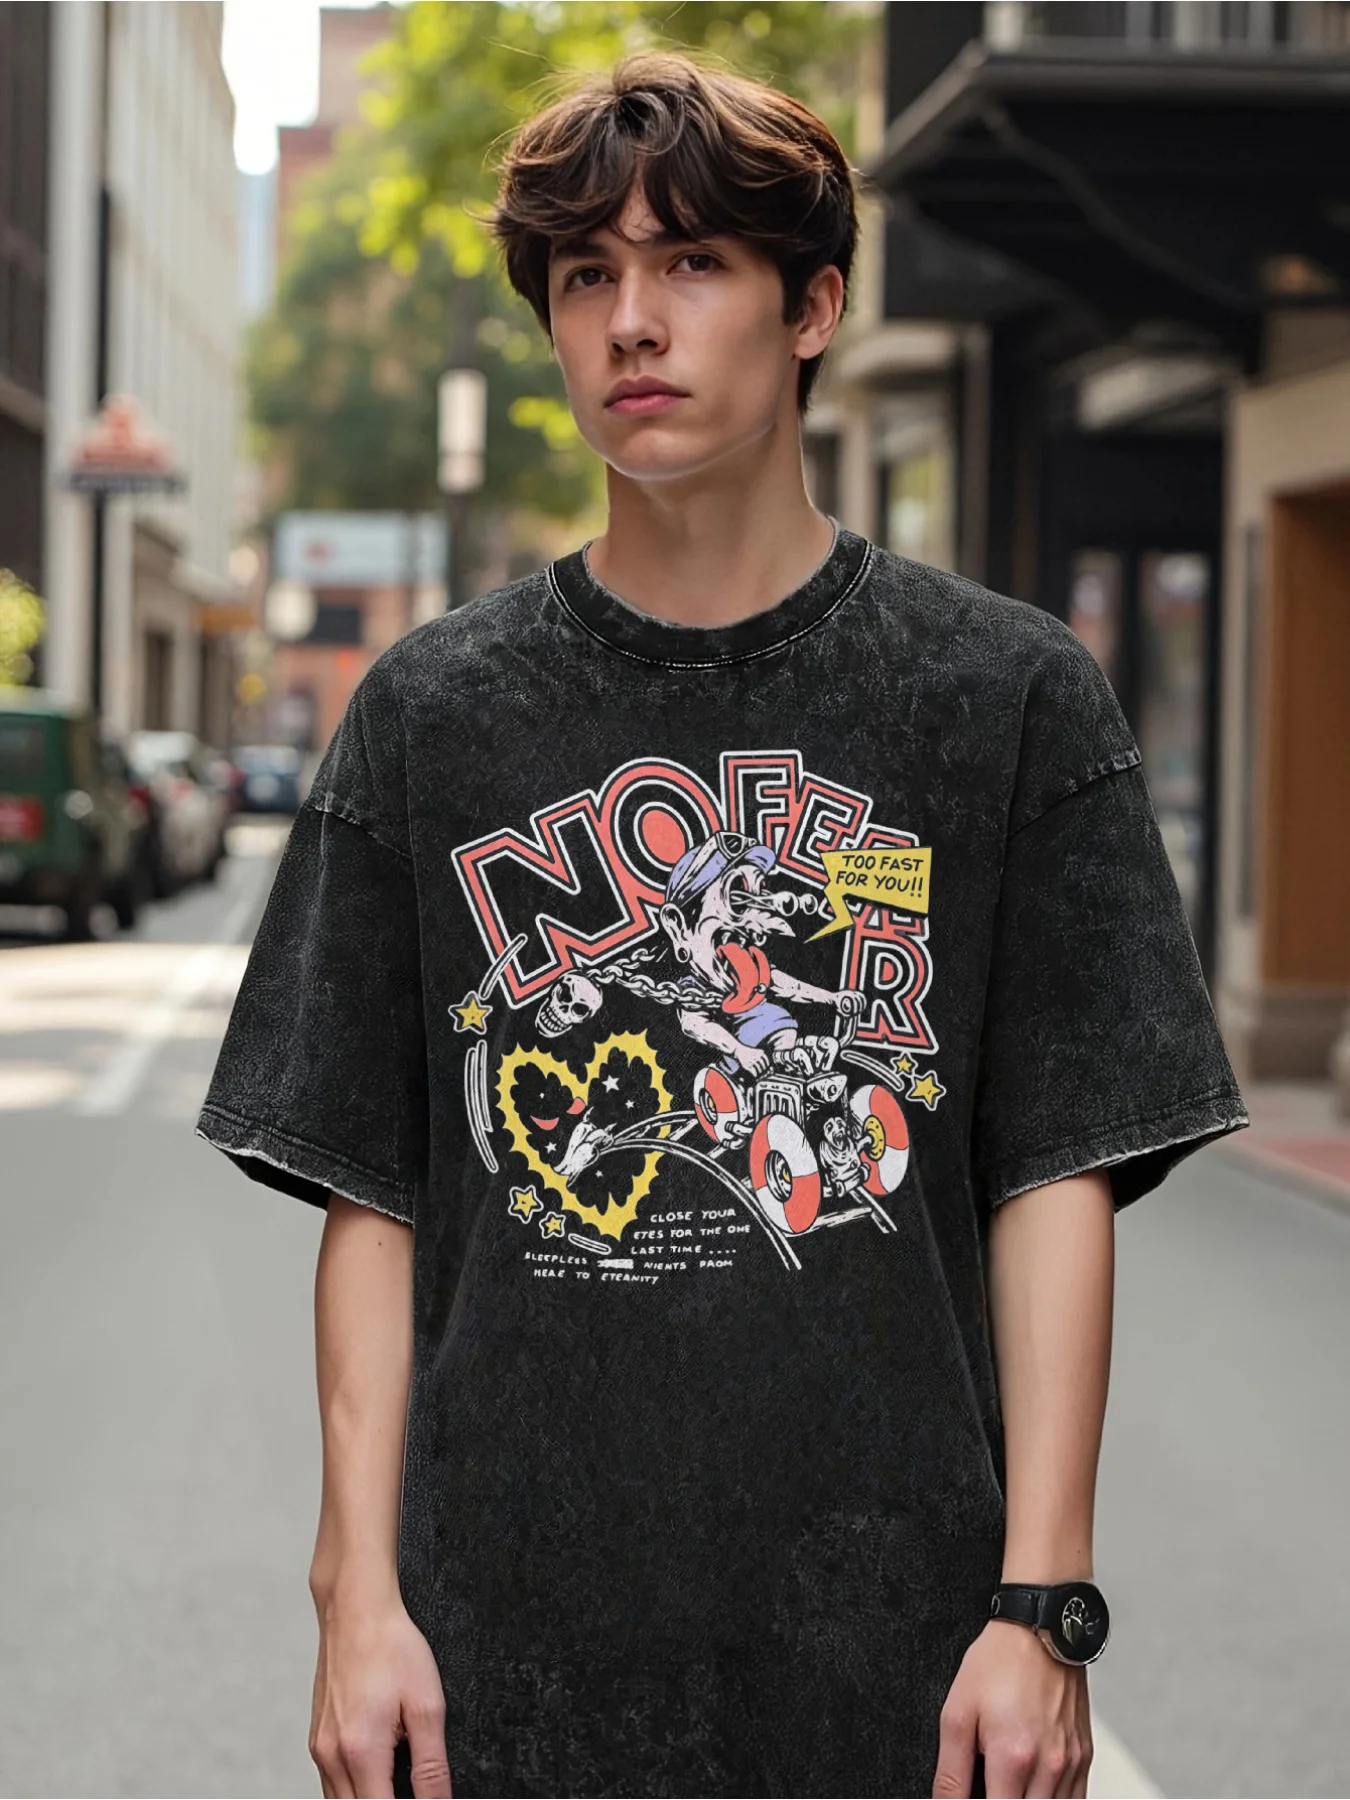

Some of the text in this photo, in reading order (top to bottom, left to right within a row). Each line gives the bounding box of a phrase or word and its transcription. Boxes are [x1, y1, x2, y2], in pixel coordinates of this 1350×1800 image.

[840, 854, 924, 872] TOO FAST
[835, 871, 924, 898] FOR YOU!!
[650, 1210, 694, 1223] CLOSE
[670, 1228, 693, 1238] FOR
[699, 1226, 722, 1236] THE
[630, 1245, 665, 1255] LAST
[669, 1244, 702, 1254] TIME
[575, 1271, 590, 1280] TO
